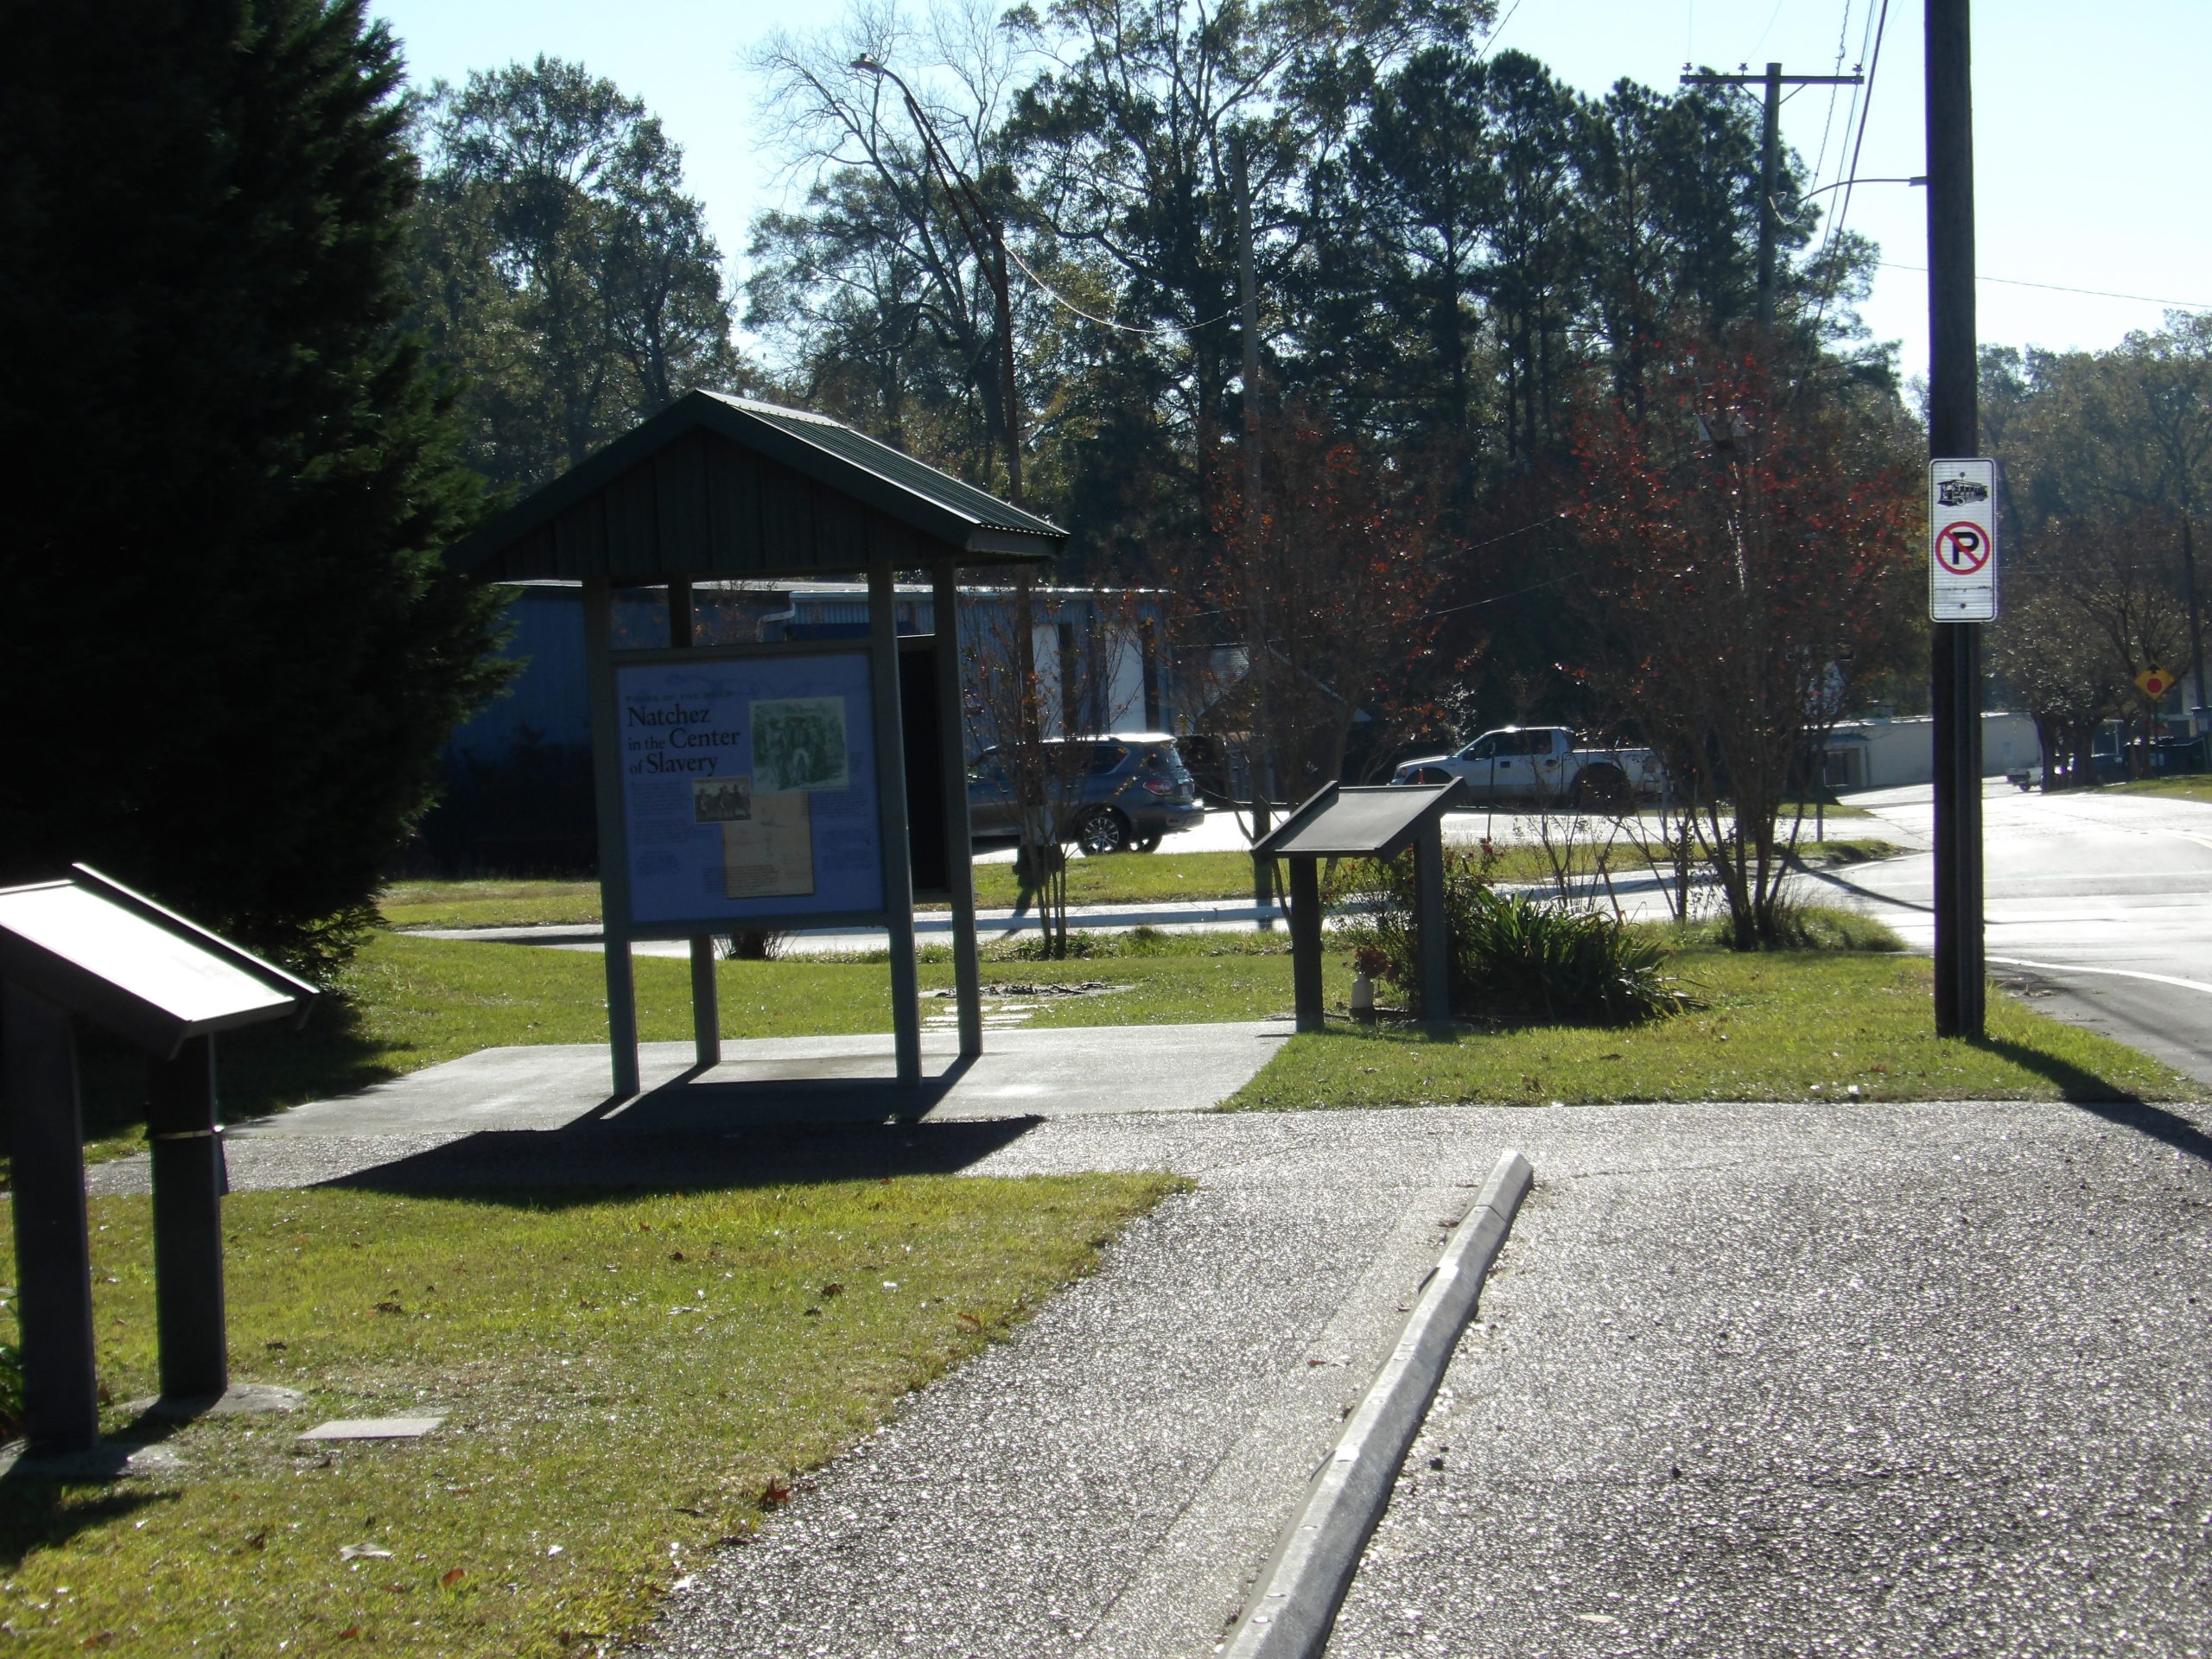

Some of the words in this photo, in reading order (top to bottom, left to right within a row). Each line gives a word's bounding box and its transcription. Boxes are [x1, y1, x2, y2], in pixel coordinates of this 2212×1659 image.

[1952, 531, 1980, 565] P
[627, 702, 711, 727] Natchez
[628, 736, 641, 751] in
[645, 734, 665, 750] the
[669, 728, 741, 749] Center
[629, 760, 644, 775] of
[645, 752, 719, 777] Slavery
